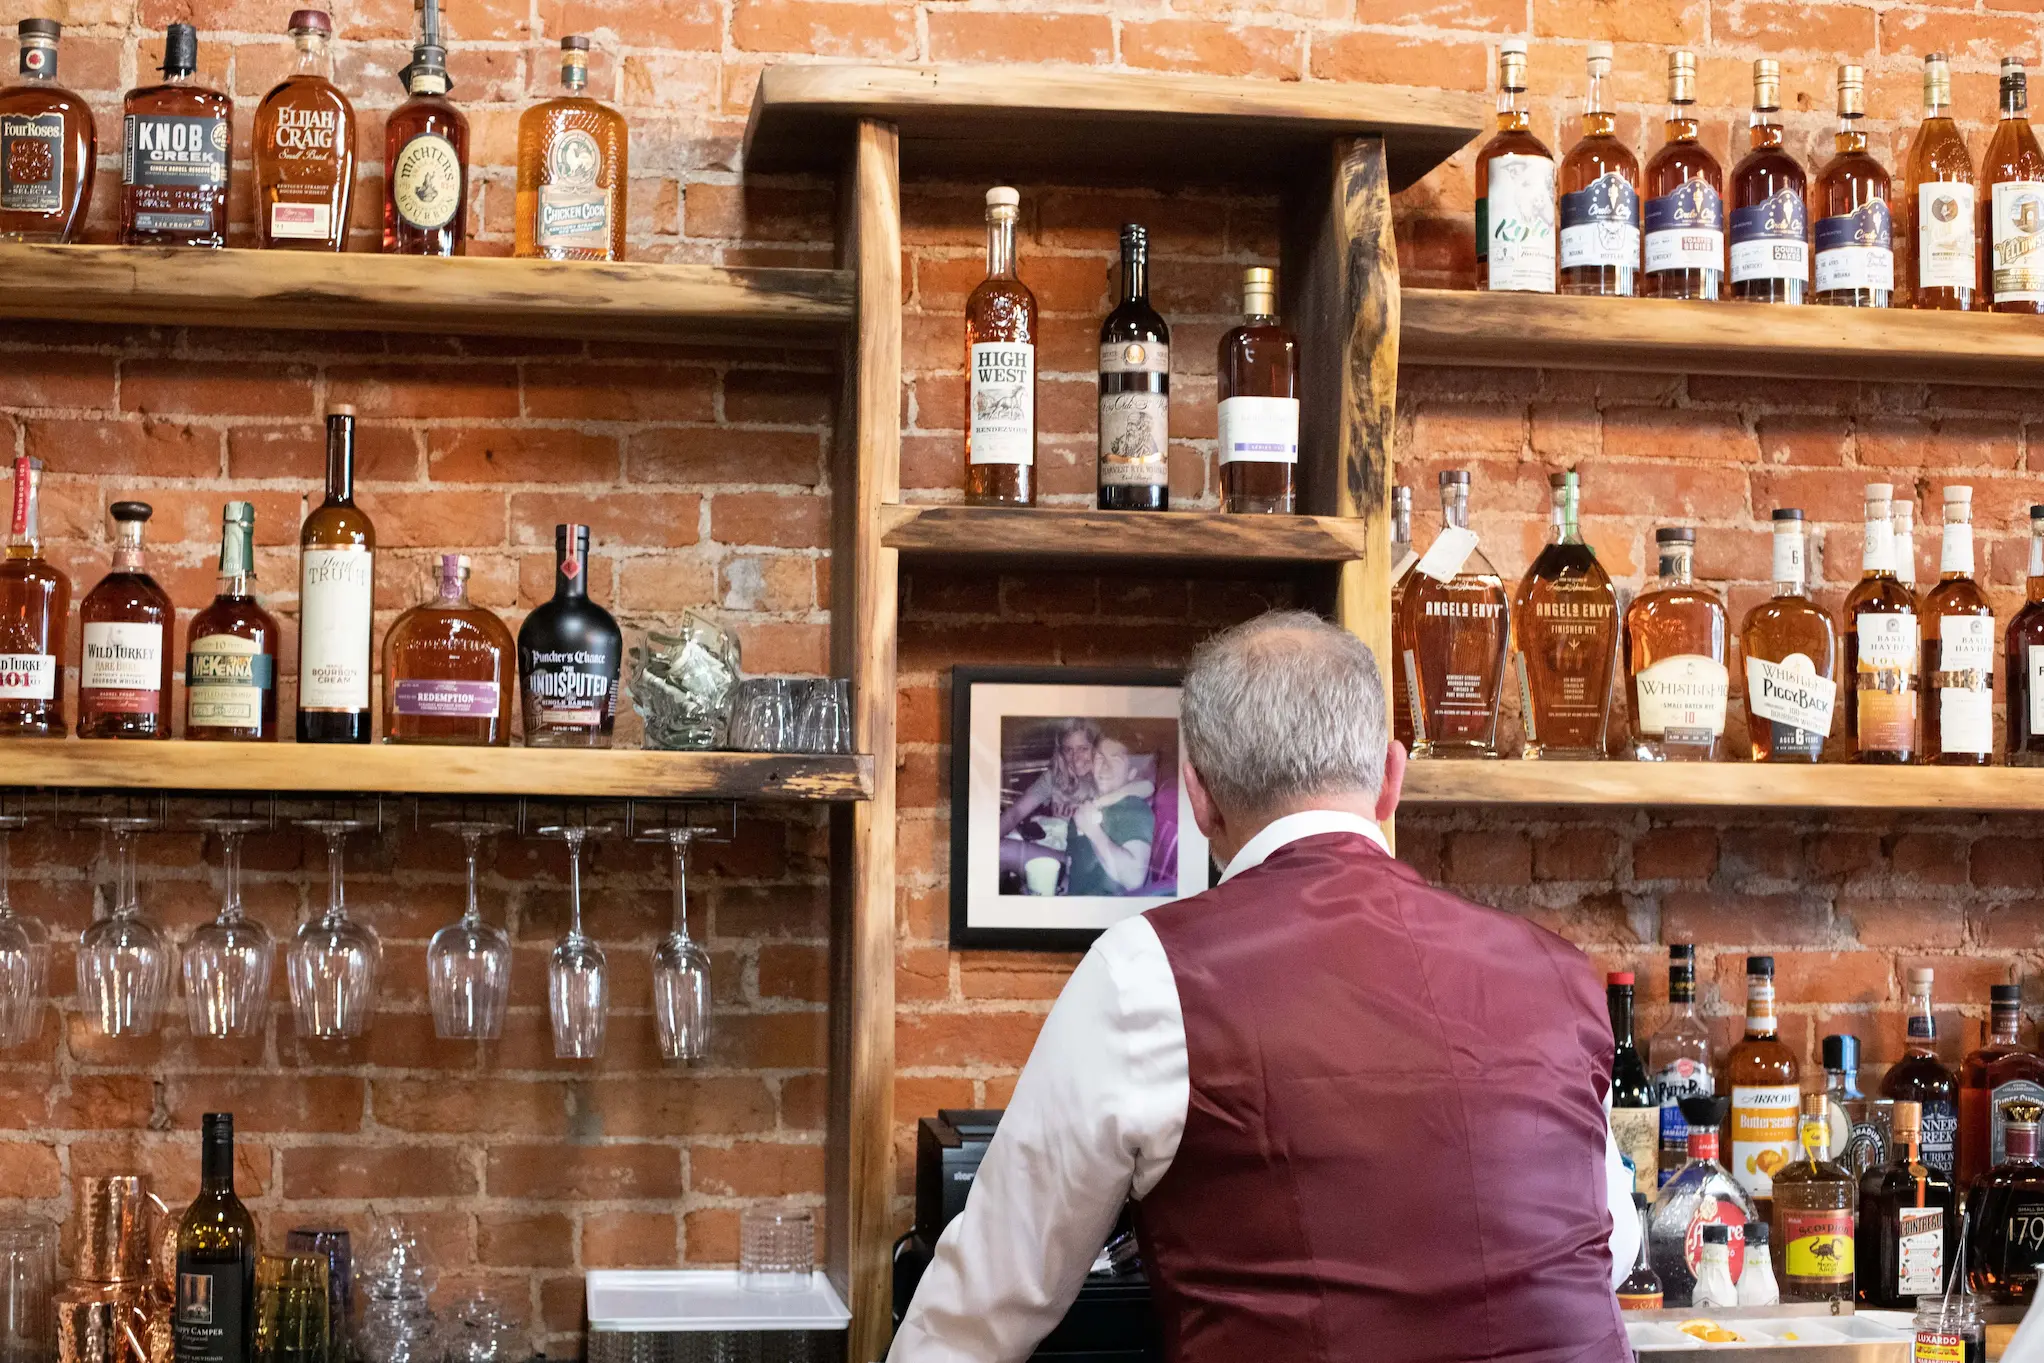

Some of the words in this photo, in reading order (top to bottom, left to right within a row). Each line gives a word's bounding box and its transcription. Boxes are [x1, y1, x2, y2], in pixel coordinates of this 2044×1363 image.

[277, 106, 334, 130] ELIJAH
[139, 122, 203, 151] KNOB
[275, 126, 333, 149] CRAIG
[150, 150, 215, 162] CREEK
[210, 162, 221, 182] 9
[543, 205, 581, 224] CHICKEN
[582, 203, 605, 219] COCK
[978, 351, 1027, 368] HIGH
[978, 368, 1027, 383] WEST
[976, 426, 1028, 434] RENDEZVOUS
[309, 566, 365, 586] TRUTH
[1472, 602, 1500, 619] ENVY
[1583, 603, 1611, 618] ENVY
[1551, 624, 1583, 635] FINISHED
[1584, 625, 1597, 635] RYE
[88, 643, 113, 659] WILD
[113, 644, 155, 660] TURKEY
[215, 641, 227, 650] 10
[532, 650, 574, 668] Puncher's
[574, 650, 606, 664] Chance
[312, 668, 358, 677] BOURBON
[317, 676, 351, 684] CREAM
[530, 671, 608, 698] UNDISPUTED
[417, 692, 474, 704] REDEMPTION
[1684, 711, 1696, 724] 10
[1795, 728, 1805, 745] 6
[1922, 1117, 1958, 1131] NNER'S
[1922, 1131, 1954, 1143] REEK
[1901, 1214, 1943, 1237] COINTREAU
[2009, 1212, 2044, 1251] 179
[190, 1326, 224, 1337] CAMPER
[1917, 1333, 1958, 1346] LUXARDO
